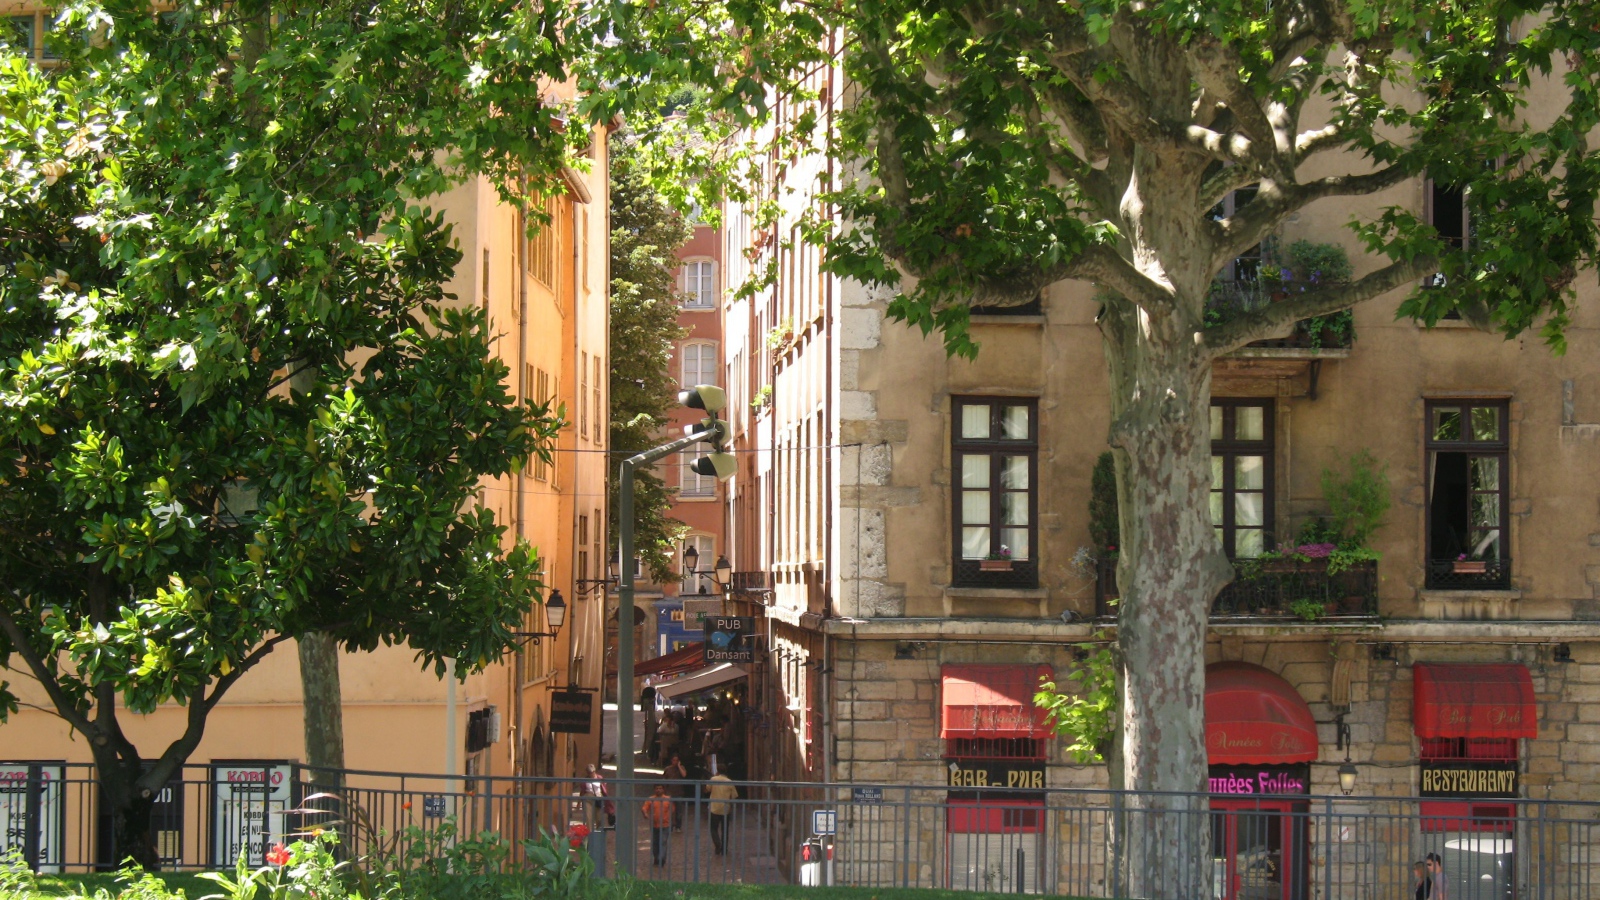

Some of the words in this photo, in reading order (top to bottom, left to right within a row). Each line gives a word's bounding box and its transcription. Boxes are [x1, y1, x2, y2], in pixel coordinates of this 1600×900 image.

[717, 619, 741, 630] PUB
[707, 649, 751, 660] Dansant
[1440, 707, 1473, 725] Bar
[1487, 706, 1521, 725] Pub
[1208, 731, 1264, 750] Années
[950, 769, 988, 787] BAR
[1007, 770, 1043, 789] PUB
[1208, 772, 1254, 794] nnèes
[1258, 772, 1304, 795] Folles
[1422, 769, 1516, 793] RESTAURANT
